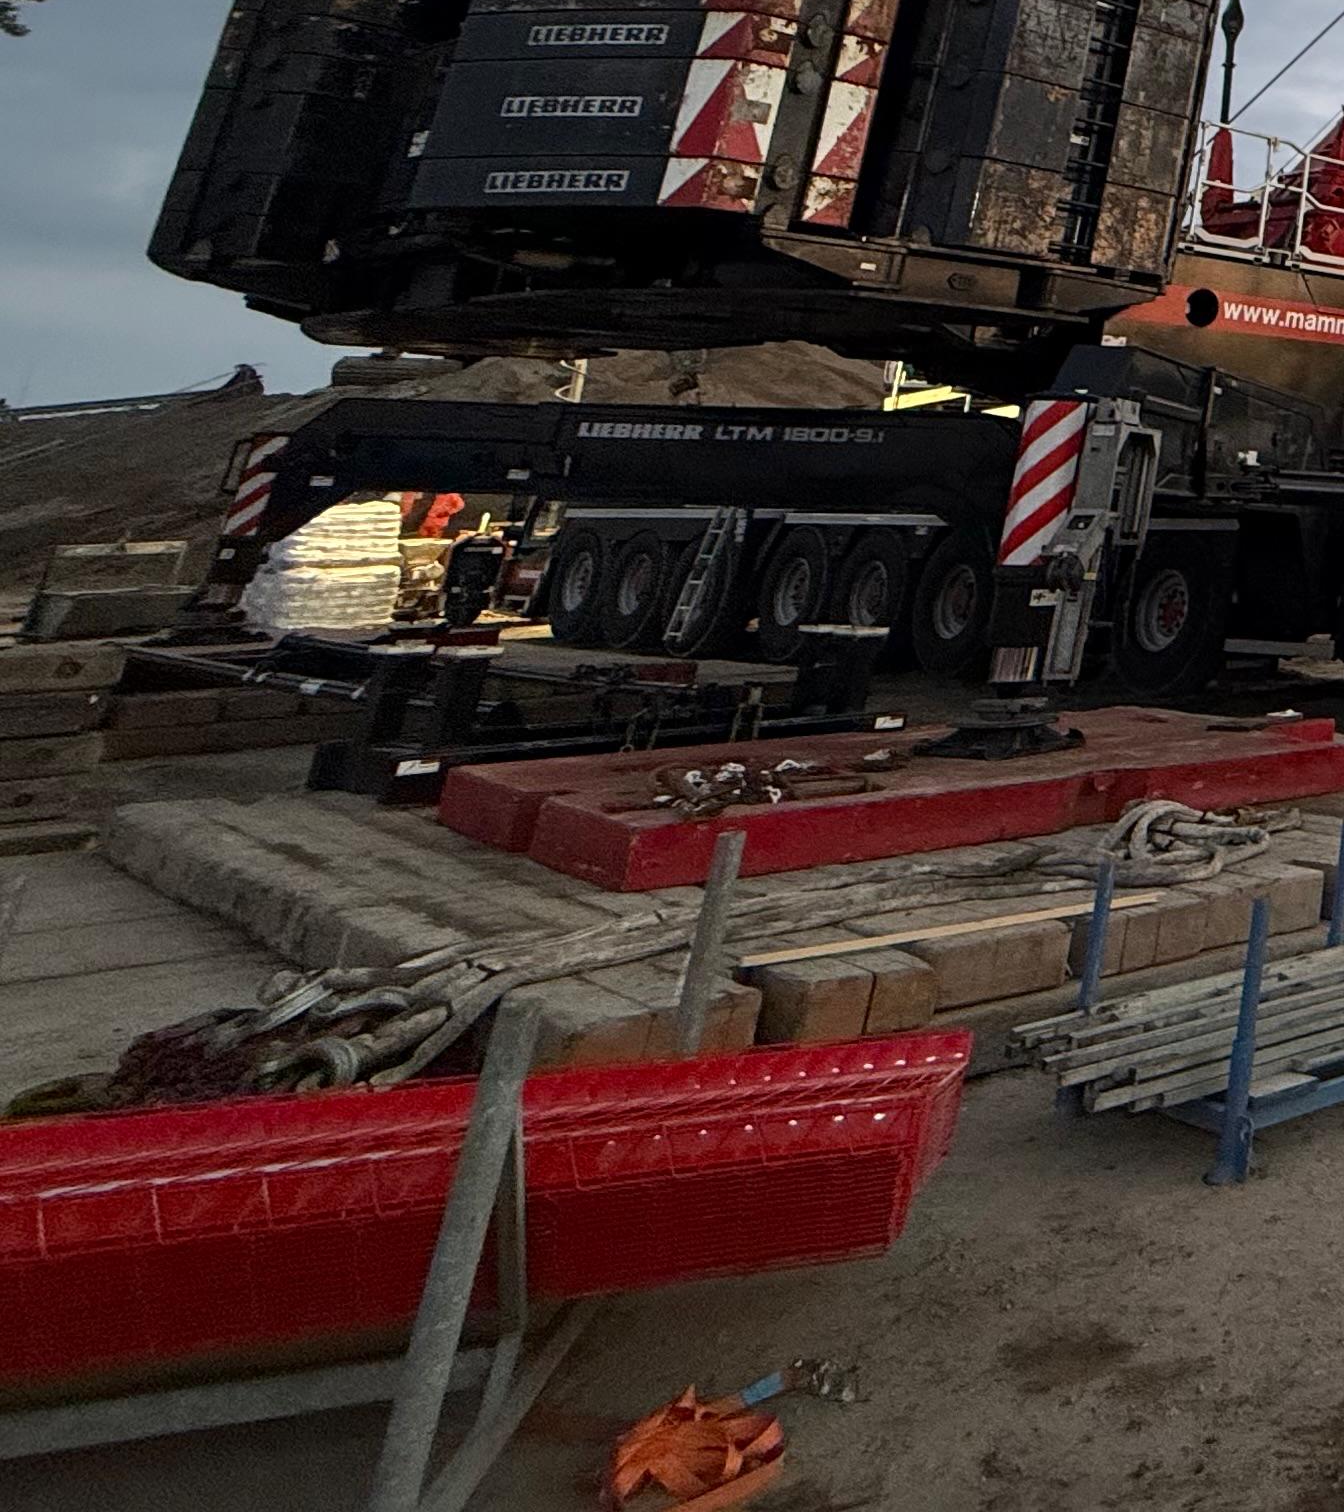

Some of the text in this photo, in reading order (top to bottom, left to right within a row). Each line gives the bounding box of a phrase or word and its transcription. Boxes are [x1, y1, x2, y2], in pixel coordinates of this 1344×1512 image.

[530, 25, 667, 44] LIEBHERR
[502, 97, 642, 115] LIEBHERR
[486, 171, 628, 192] LIEBHERR
[577, 422, 704, 439] LIEBHERR
[714, 425, 774, 441] LTM
